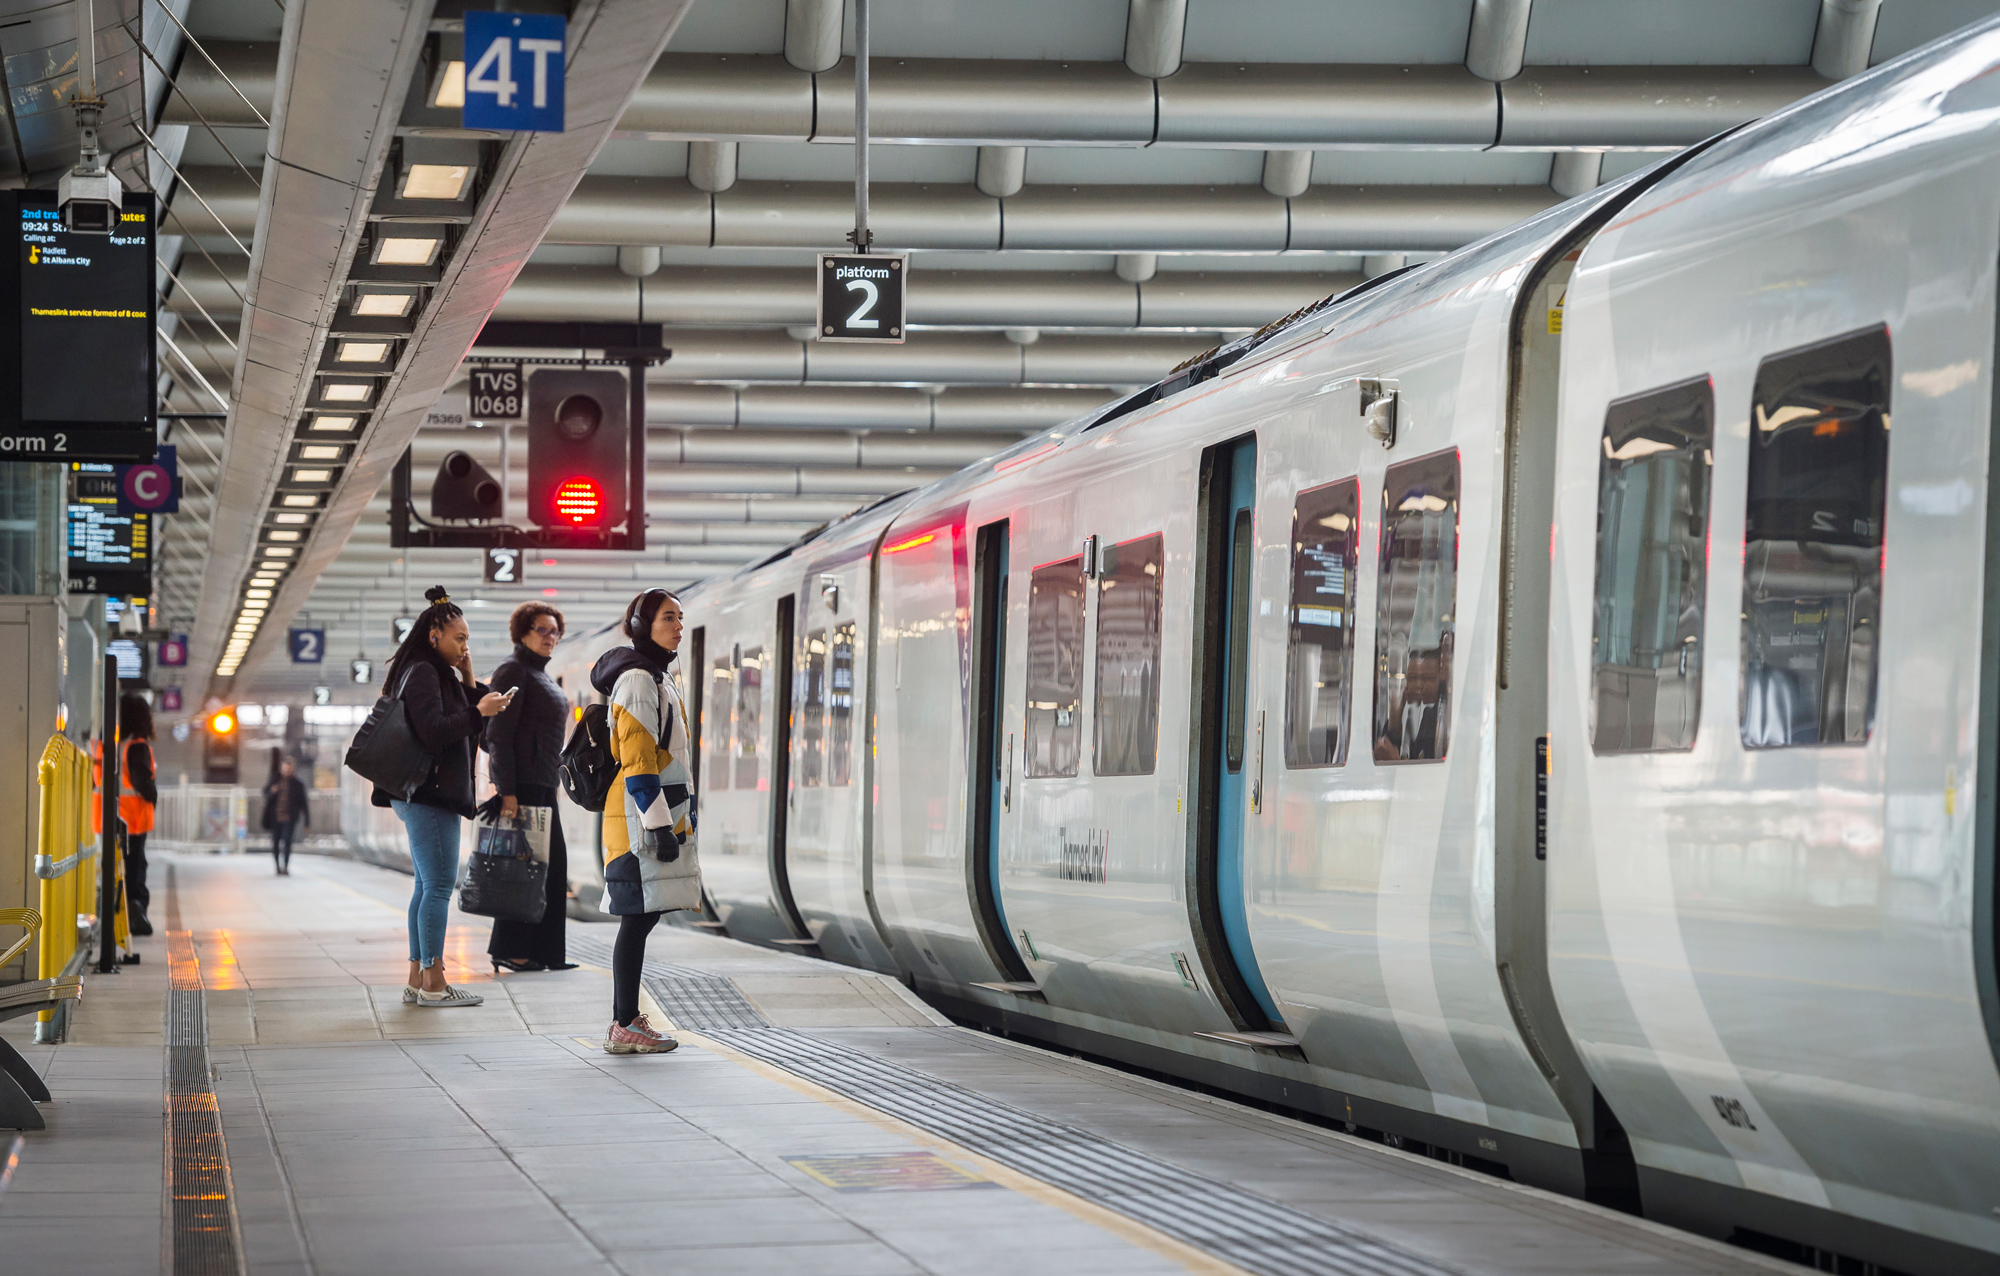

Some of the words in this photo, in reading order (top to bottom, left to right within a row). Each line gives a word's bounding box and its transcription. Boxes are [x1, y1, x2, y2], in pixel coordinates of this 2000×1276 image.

[467, 36, 562, 108] 4T
[22, 209, 41, 219] 2nd
[43, 210, 59, 220] trai
[121, 213, 146, 222] utes
[22, 222, 49, 232] 09:24
[52, 222, 63, 232] St
[23, 234, 47, 243] Calling
[110, 236, 126, 246] Page
[127, 236, 132, 245] 2
[132, 236, 140, 245] of
[140, 237, 146, 245] 2
[42, 247, 67, 255] Radlett
[42, 256, 51, 265] St
[51, 256, 75, 265] Albans
[76, 257, 91, 266] City
[836, 265, 889, 280] platform
[845, 279, 879, 329] 2
[31, 308, 68, 316] Thameslink
[69, 309, 92, 317] service
[93, 309, 117, 318] formed
[118, 310, 125, 318] of
[475, 372, 517, 392] TVS
[474, 395, 518, 415] 1068
[0, 433, 46, 452] orm
[53, 432, 67, 452] 2
[134, 470, 159, 500] C
[494, 553, 515, 582] 2
[87, 575, 97, 590] 2
[298, 632, 318, 660] 2
